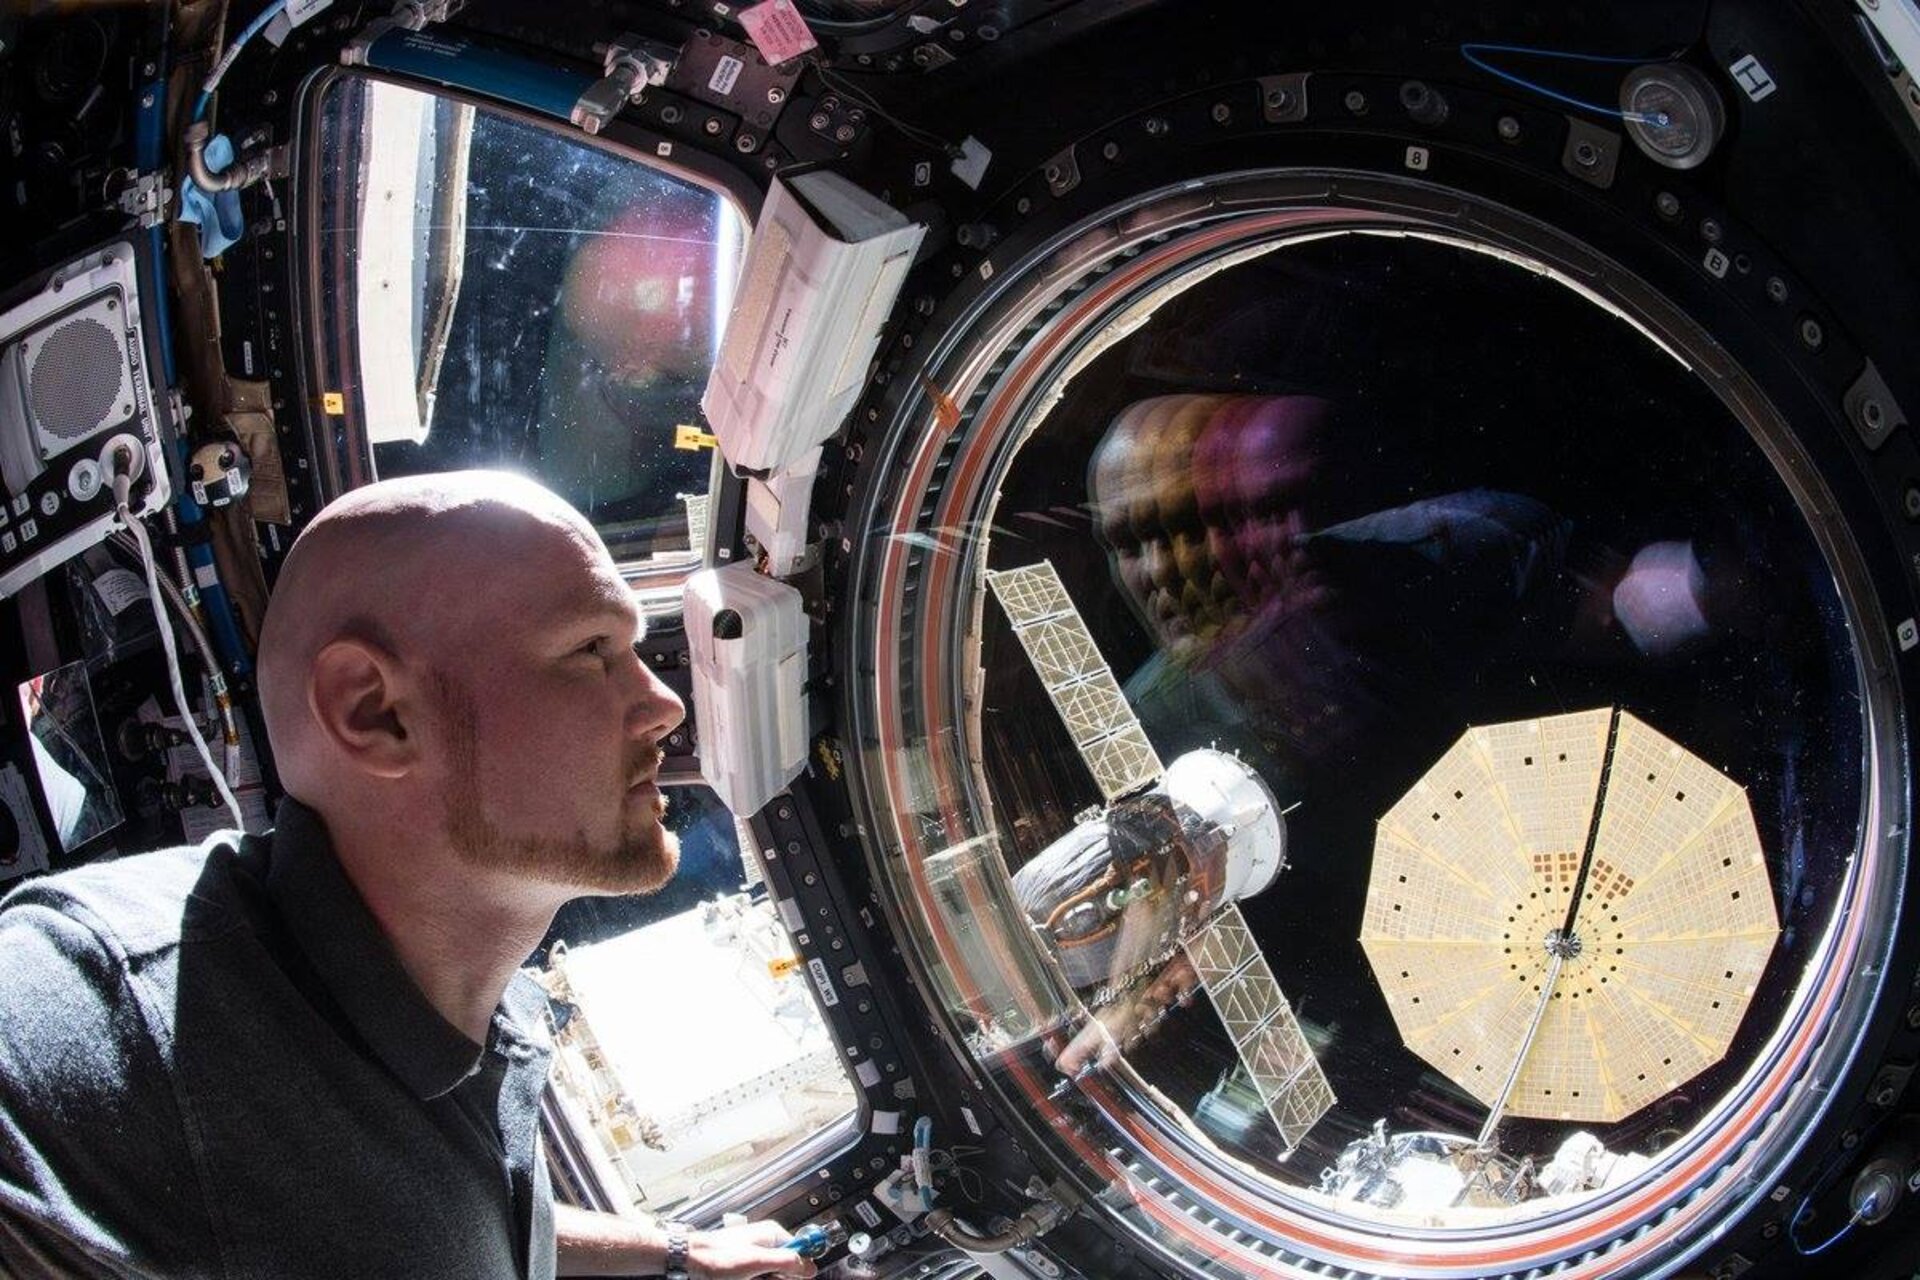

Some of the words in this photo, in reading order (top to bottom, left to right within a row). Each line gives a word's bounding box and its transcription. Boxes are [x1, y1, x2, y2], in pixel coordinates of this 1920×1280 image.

[1736, 61, 1770, 94] H
[1412, 151, 1421, 165] 8
[1710, 255, 1723, 271] B
[128, 337, 138, 365] AUDIO
